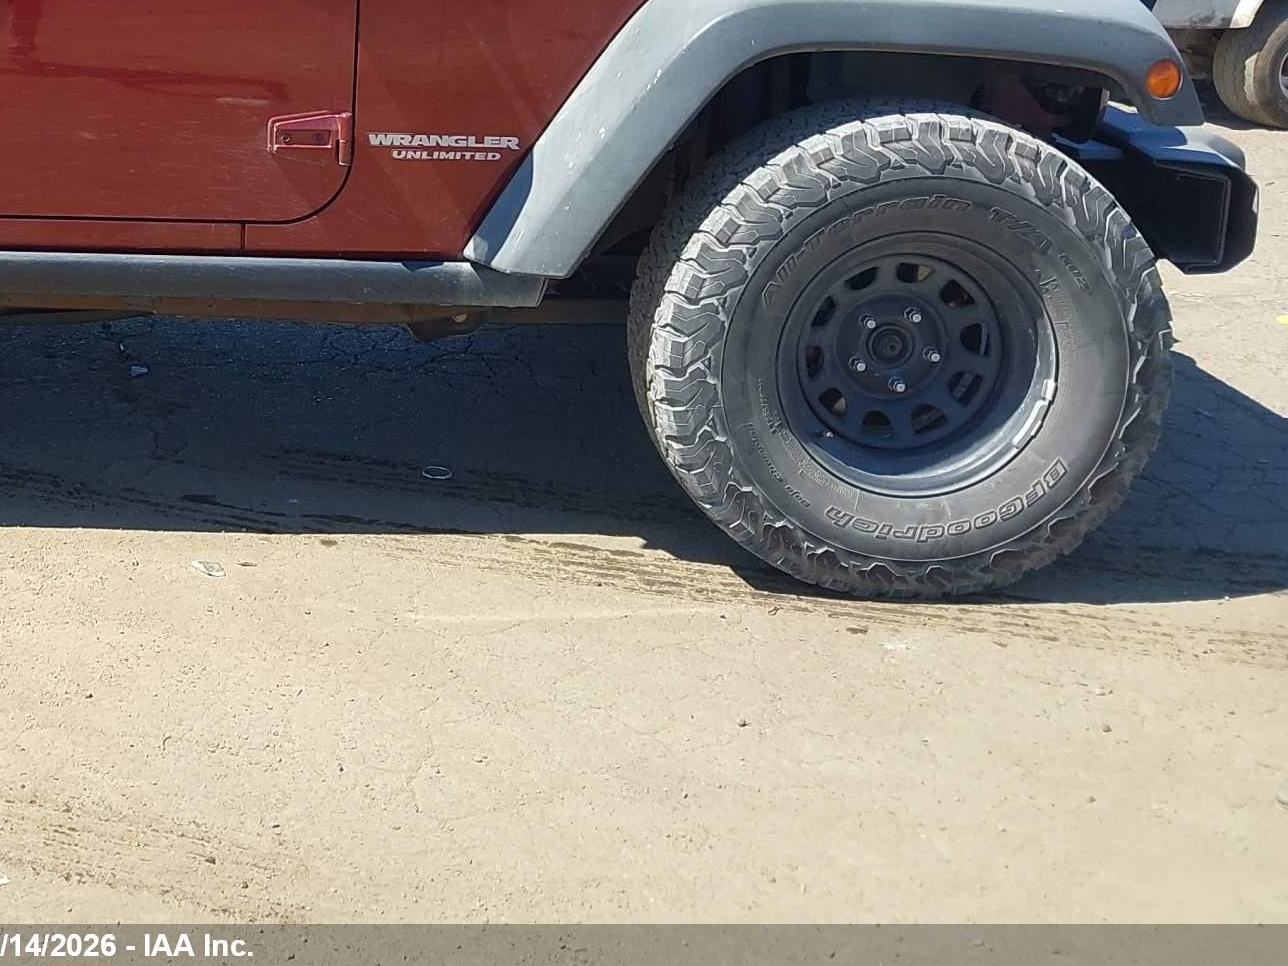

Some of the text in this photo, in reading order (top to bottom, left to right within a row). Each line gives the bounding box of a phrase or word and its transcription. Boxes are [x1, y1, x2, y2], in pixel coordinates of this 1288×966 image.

[368, 133, 520, 150] WRANGLER
[392, 150, 501, 161] UNLIMITED
[762, 194, 972, 310] All-Terrain
[990, 206, 1051, 251] T/A
[824, 457, 1068, 543] BFGoodrich
